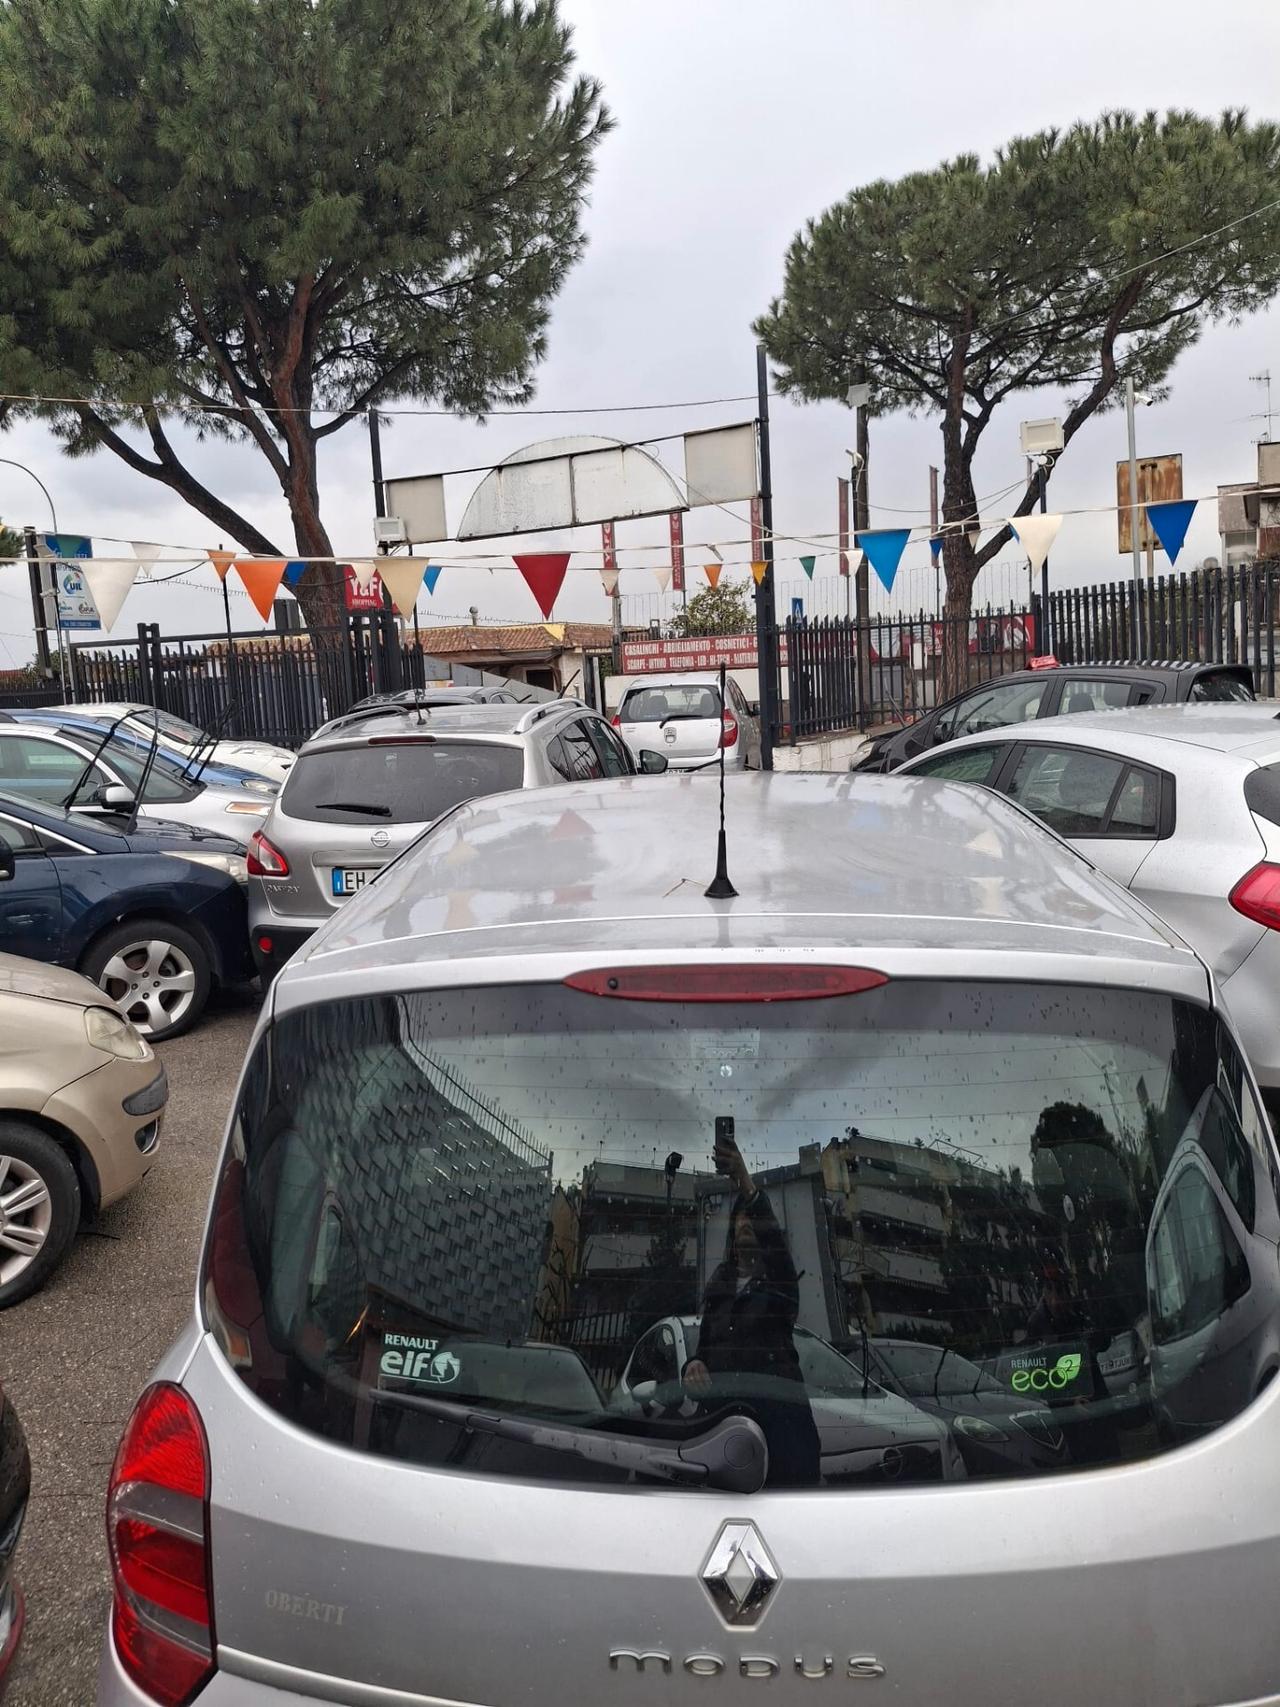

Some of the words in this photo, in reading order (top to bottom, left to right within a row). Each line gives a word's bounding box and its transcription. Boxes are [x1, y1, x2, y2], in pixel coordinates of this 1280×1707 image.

[663, 640, 711, 654] ABBIGLIAMENTO
[715, 637, 750, 650] COSMETICI
[385, 1333, 439, 1351] RENAULT
[380, 1350, 431, 1377] elf
[1011, 1357, 1047, 1369] RENAULT
[264, 1590, 345, 1625] OBERTI
